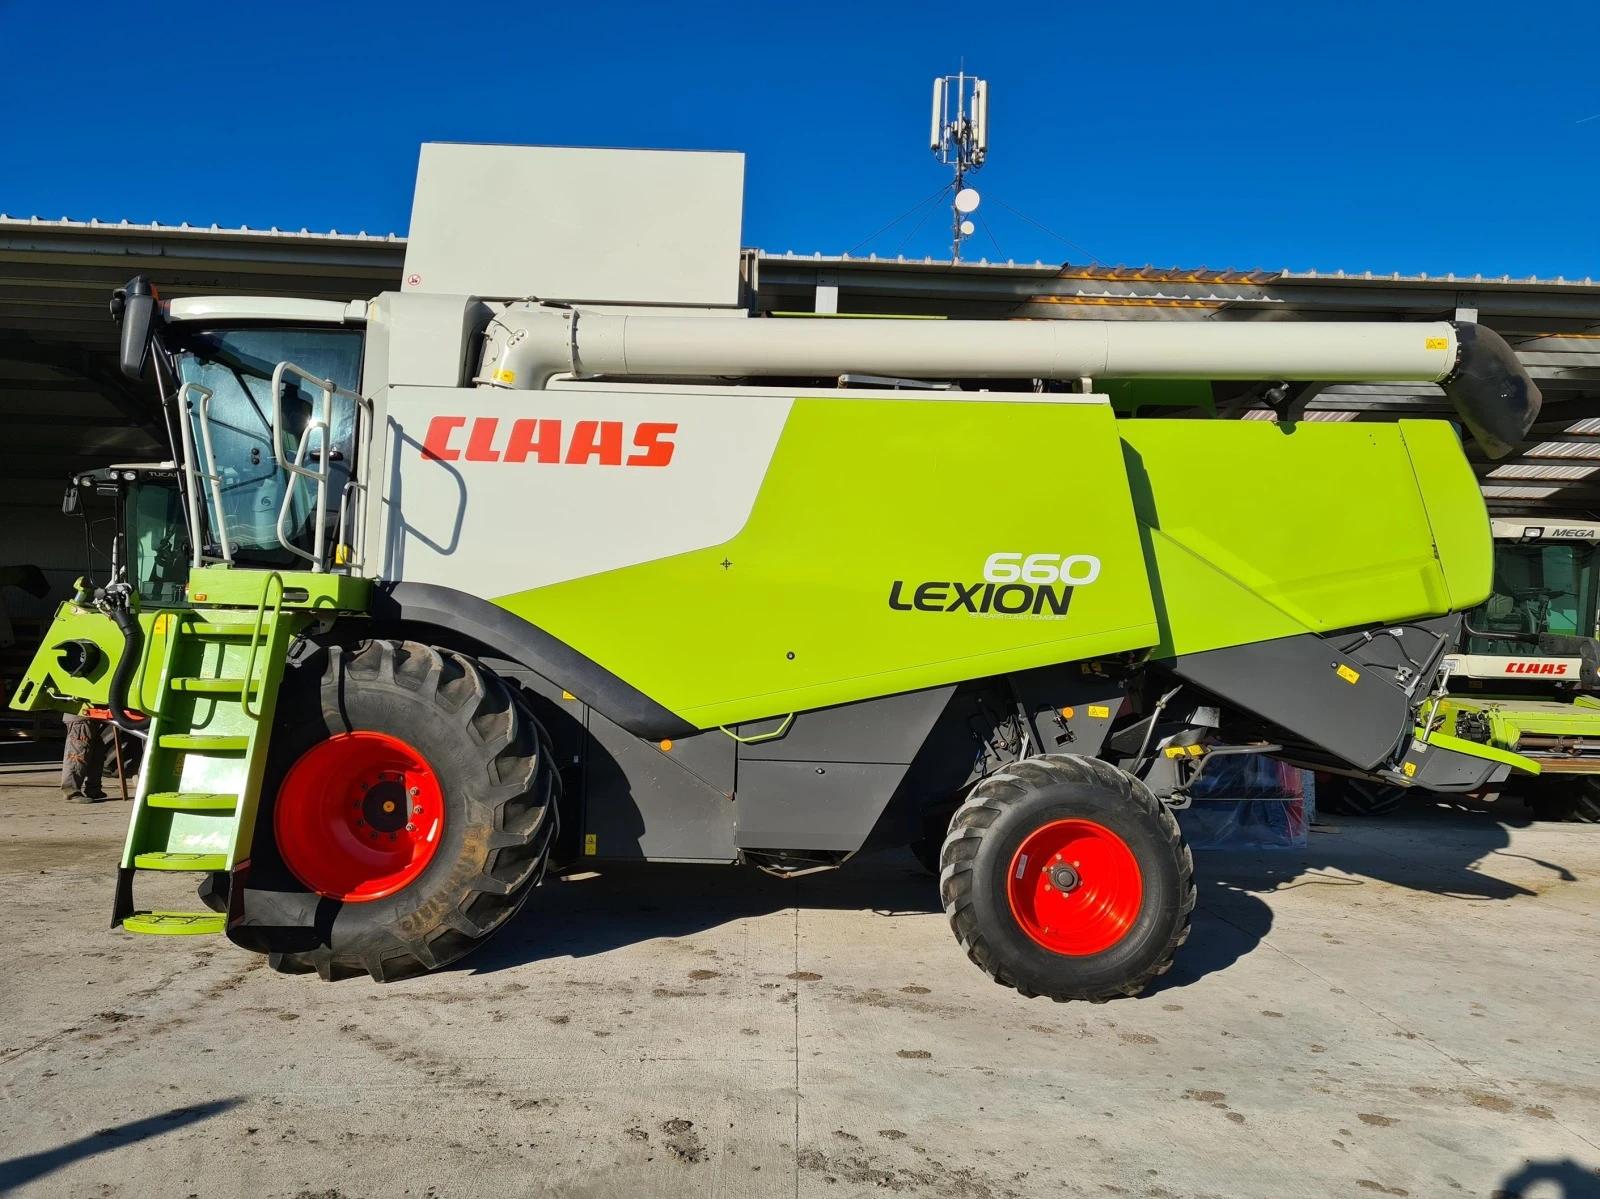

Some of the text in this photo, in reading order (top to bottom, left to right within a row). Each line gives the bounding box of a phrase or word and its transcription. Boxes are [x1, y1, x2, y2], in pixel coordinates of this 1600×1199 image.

[421, 415, 679, 467] CLAAS
[1552, 528, 1595, 538] MEGA
[983, 552, 1101, 585] 660
[888, 580, 1075, 616] LEXION
[1505, 662, 1568, 675] CLAAS
